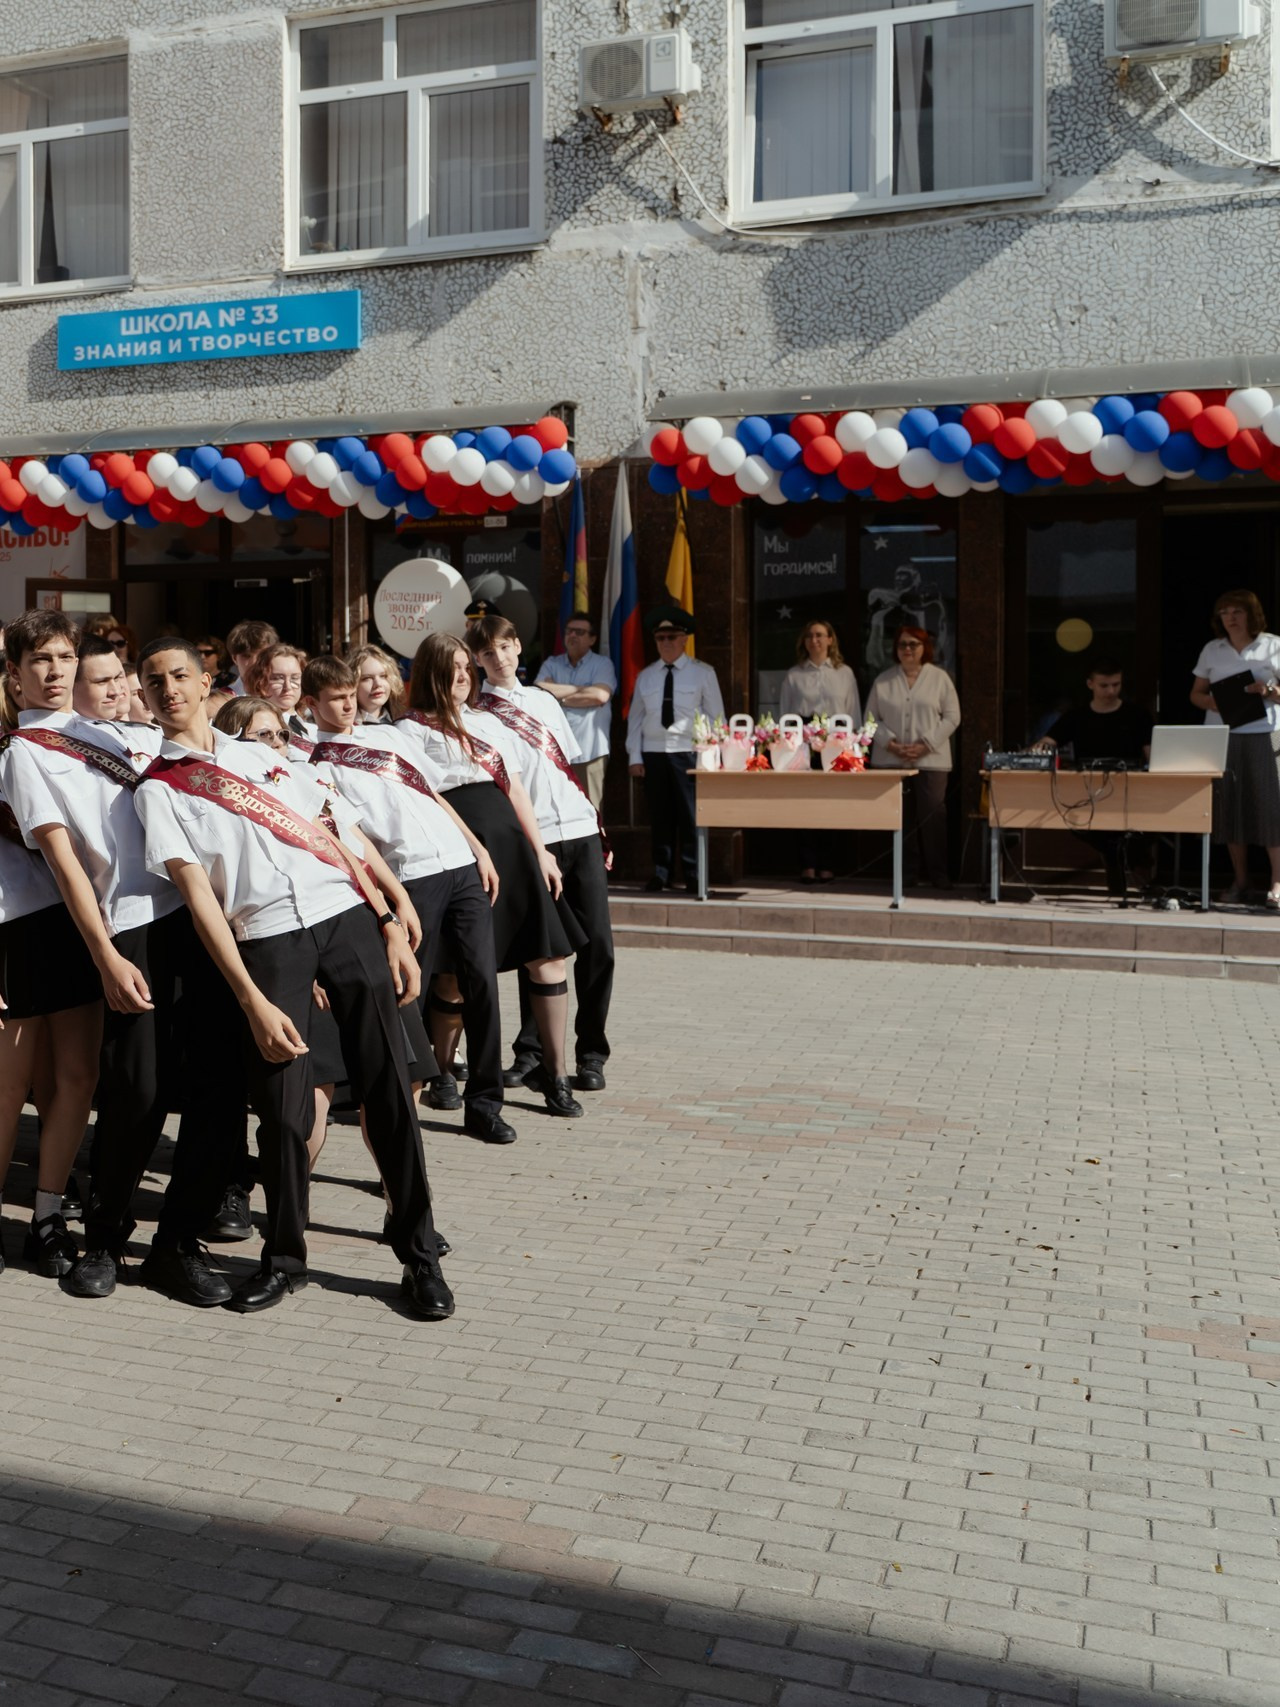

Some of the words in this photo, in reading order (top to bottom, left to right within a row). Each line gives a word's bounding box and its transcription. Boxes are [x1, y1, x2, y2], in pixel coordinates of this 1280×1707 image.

[120, 309, 212, 336] ШКОЛА
[219, 306, 247, 327] №
[251, 303, 280, 325] 33
[73, 339, 162, 362] ЗНАНИЯ
[168, 337, 182, 354] И
[188, 325, 339, 352] ТВОРЧЕСТВО
[763, 535, 790, 554] Мы
[465, 546, 518, 565] помним!
[763, 553, 837, 576] гордимся!
[379, 589, 443, 604] Последний
[387, 602, 429, 614] звонок
